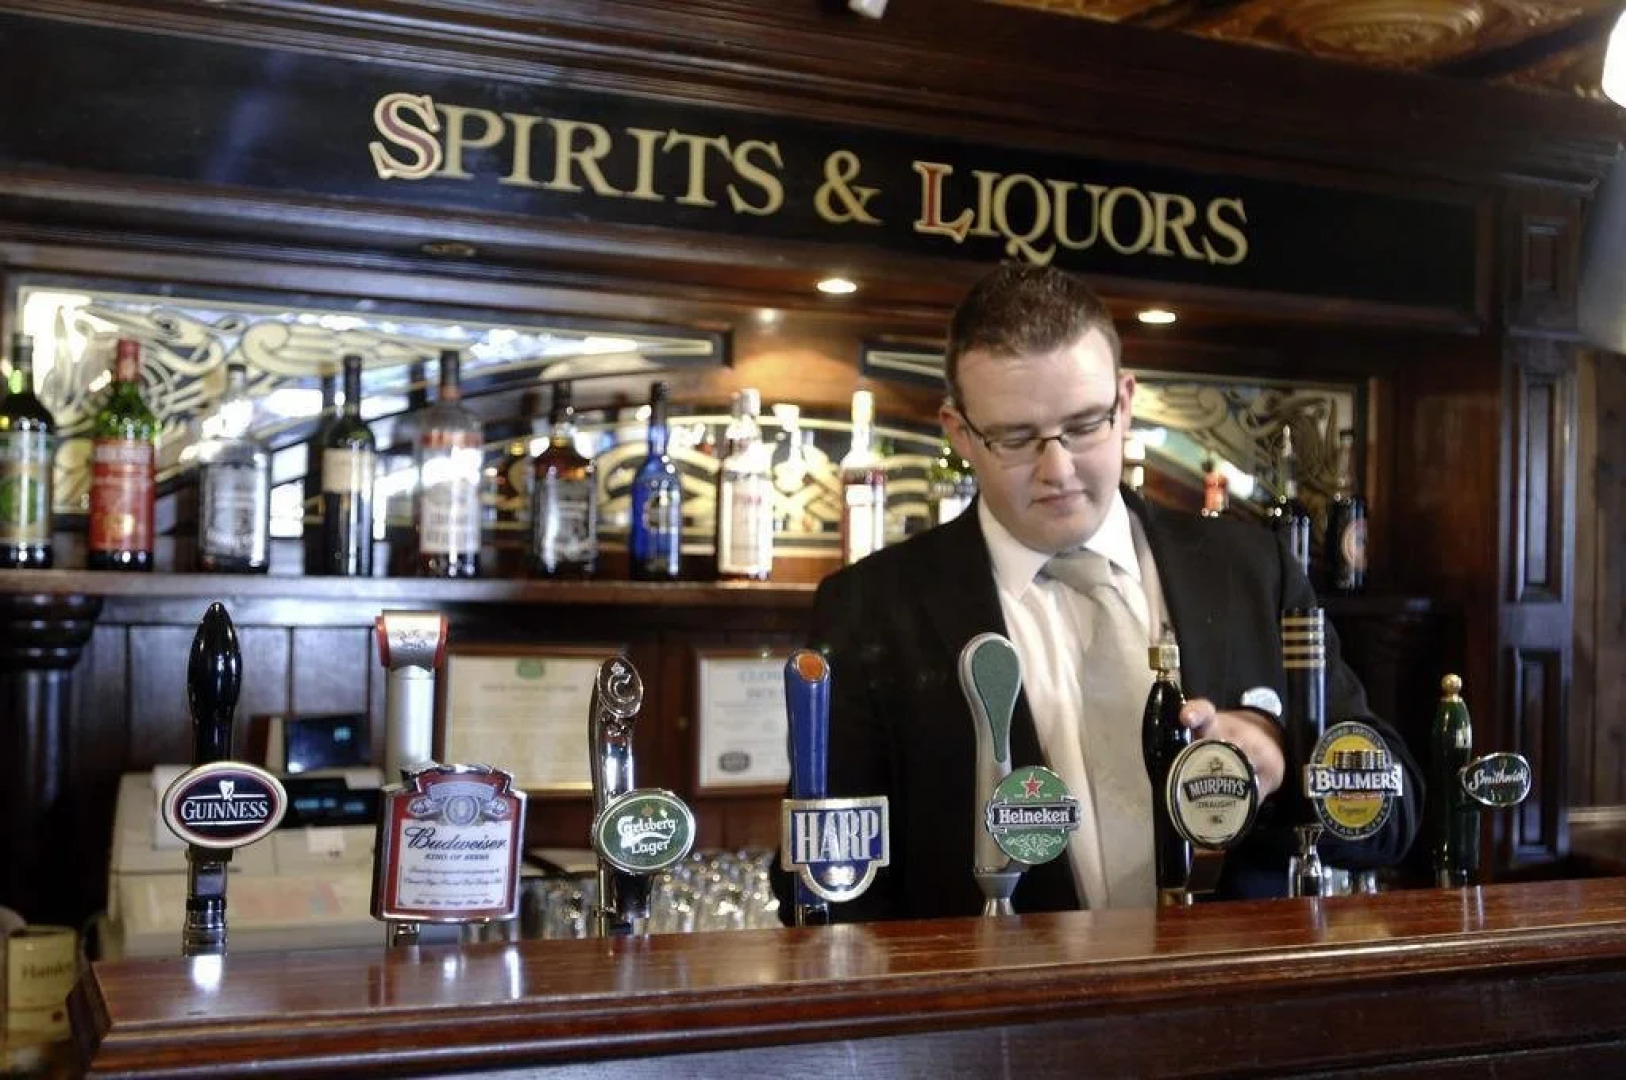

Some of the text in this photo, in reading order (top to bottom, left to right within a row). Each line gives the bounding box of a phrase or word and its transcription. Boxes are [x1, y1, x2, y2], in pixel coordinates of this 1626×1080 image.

[370, 92, 1249, 266] SPIRITS & LIQUORS
[1315, 770, 1399, 791] BULMERS
[180, 800, 269, 821] GUINNESS
[999, 807, 1070, 824] Heineken
[404, 826, 508, 850] Budweiser
[617, 816, 676, 840] Carlsberg
[794, 809, 879, 863] HARP
[631, 840, 669, 856] Lager
